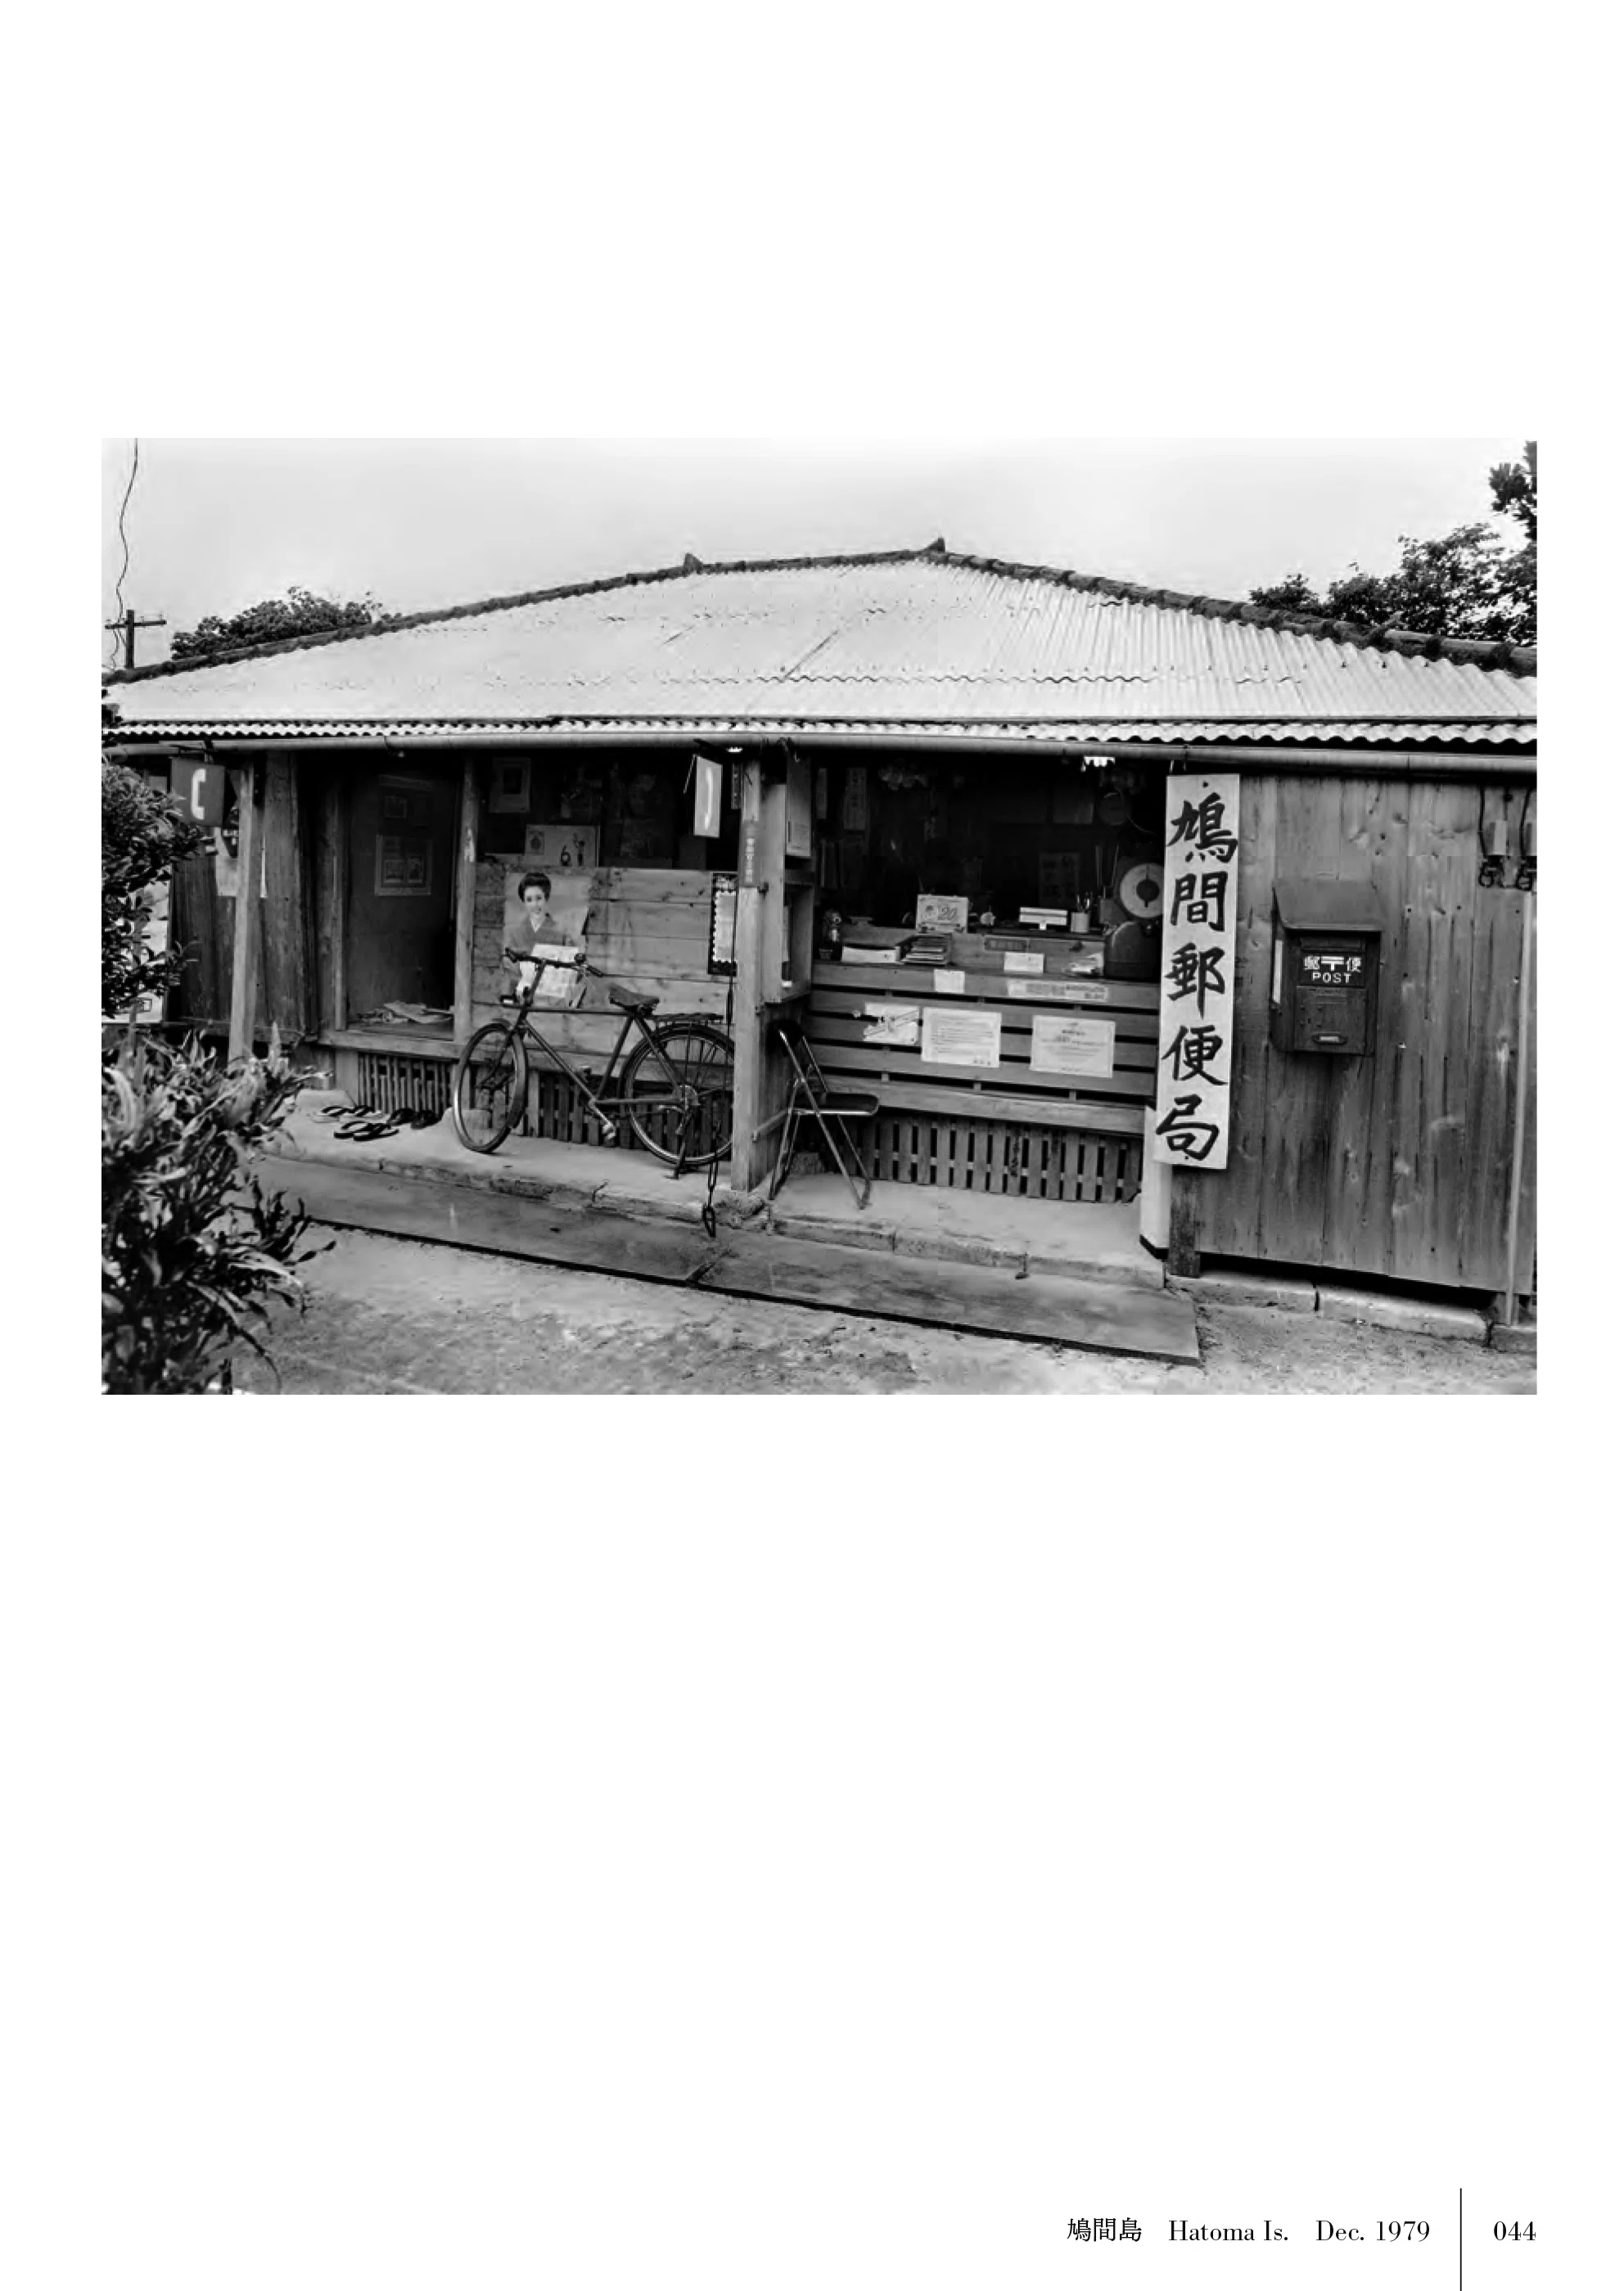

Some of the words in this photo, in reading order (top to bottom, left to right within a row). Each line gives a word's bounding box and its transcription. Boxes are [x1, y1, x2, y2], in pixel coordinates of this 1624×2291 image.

[1157, 792, 1238, 1160] 鳩間郵便局
[1312, 972, 1351, 983] POST
